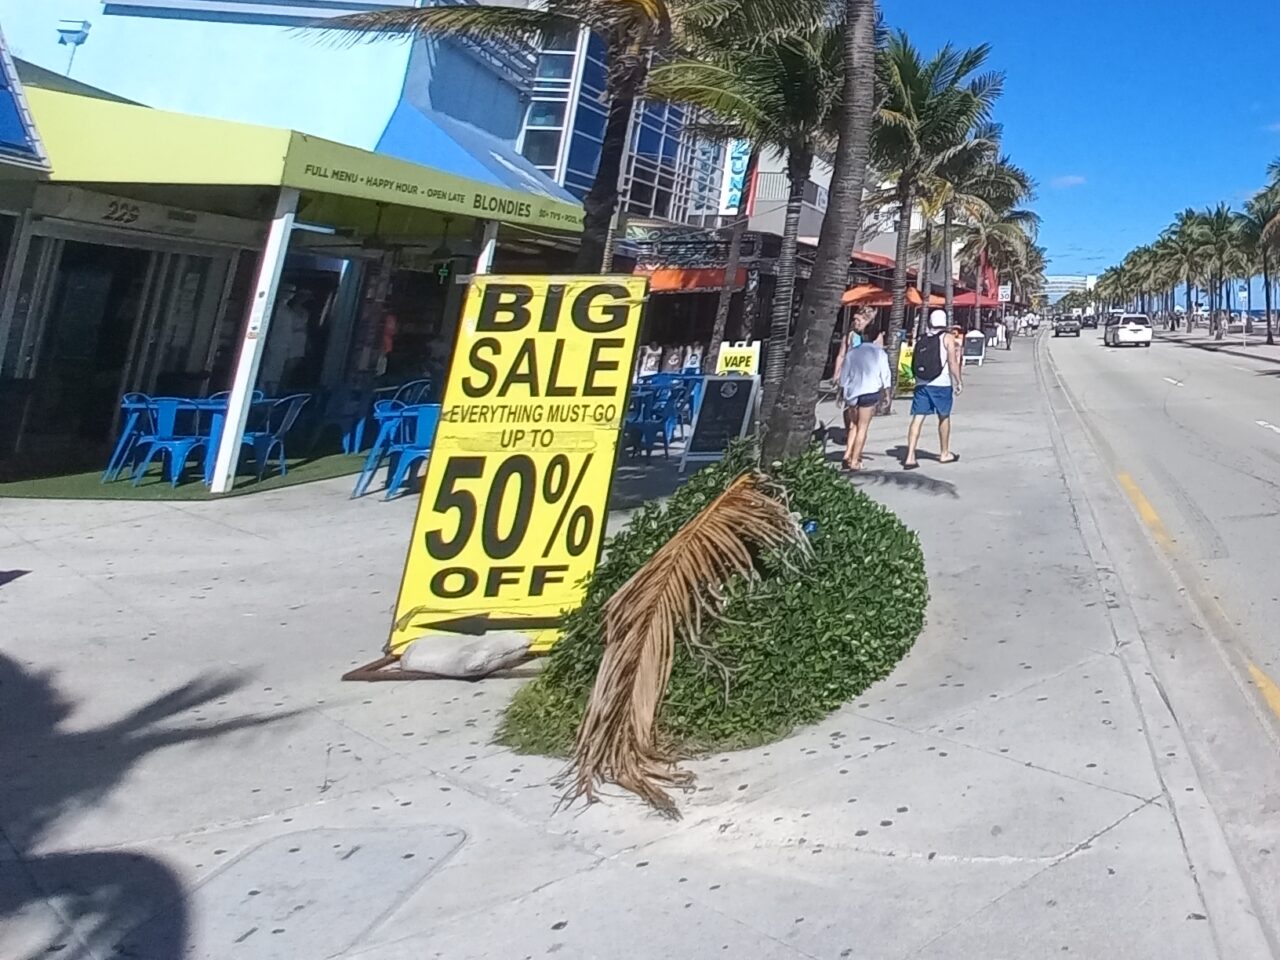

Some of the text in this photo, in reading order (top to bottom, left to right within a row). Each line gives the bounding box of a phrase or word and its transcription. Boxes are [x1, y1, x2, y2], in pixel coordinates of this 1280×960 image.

[304, 164, 466, 204] FULL MENU HAPPY HOUR OPEN LATE
[473, 194, 531, 218] BLONDIES
[475, 283, 632, 333] BIG
[461, 337, 626, 398] SALE
[724, 355, 752, 368] VAPE
[449, 404, 617, 423] EVERYTHING MUST GO
[500, 429, 555, 448] UP TO
[425, 453, 594, 561] 50%
[430, 564, 569, 599] OFF
